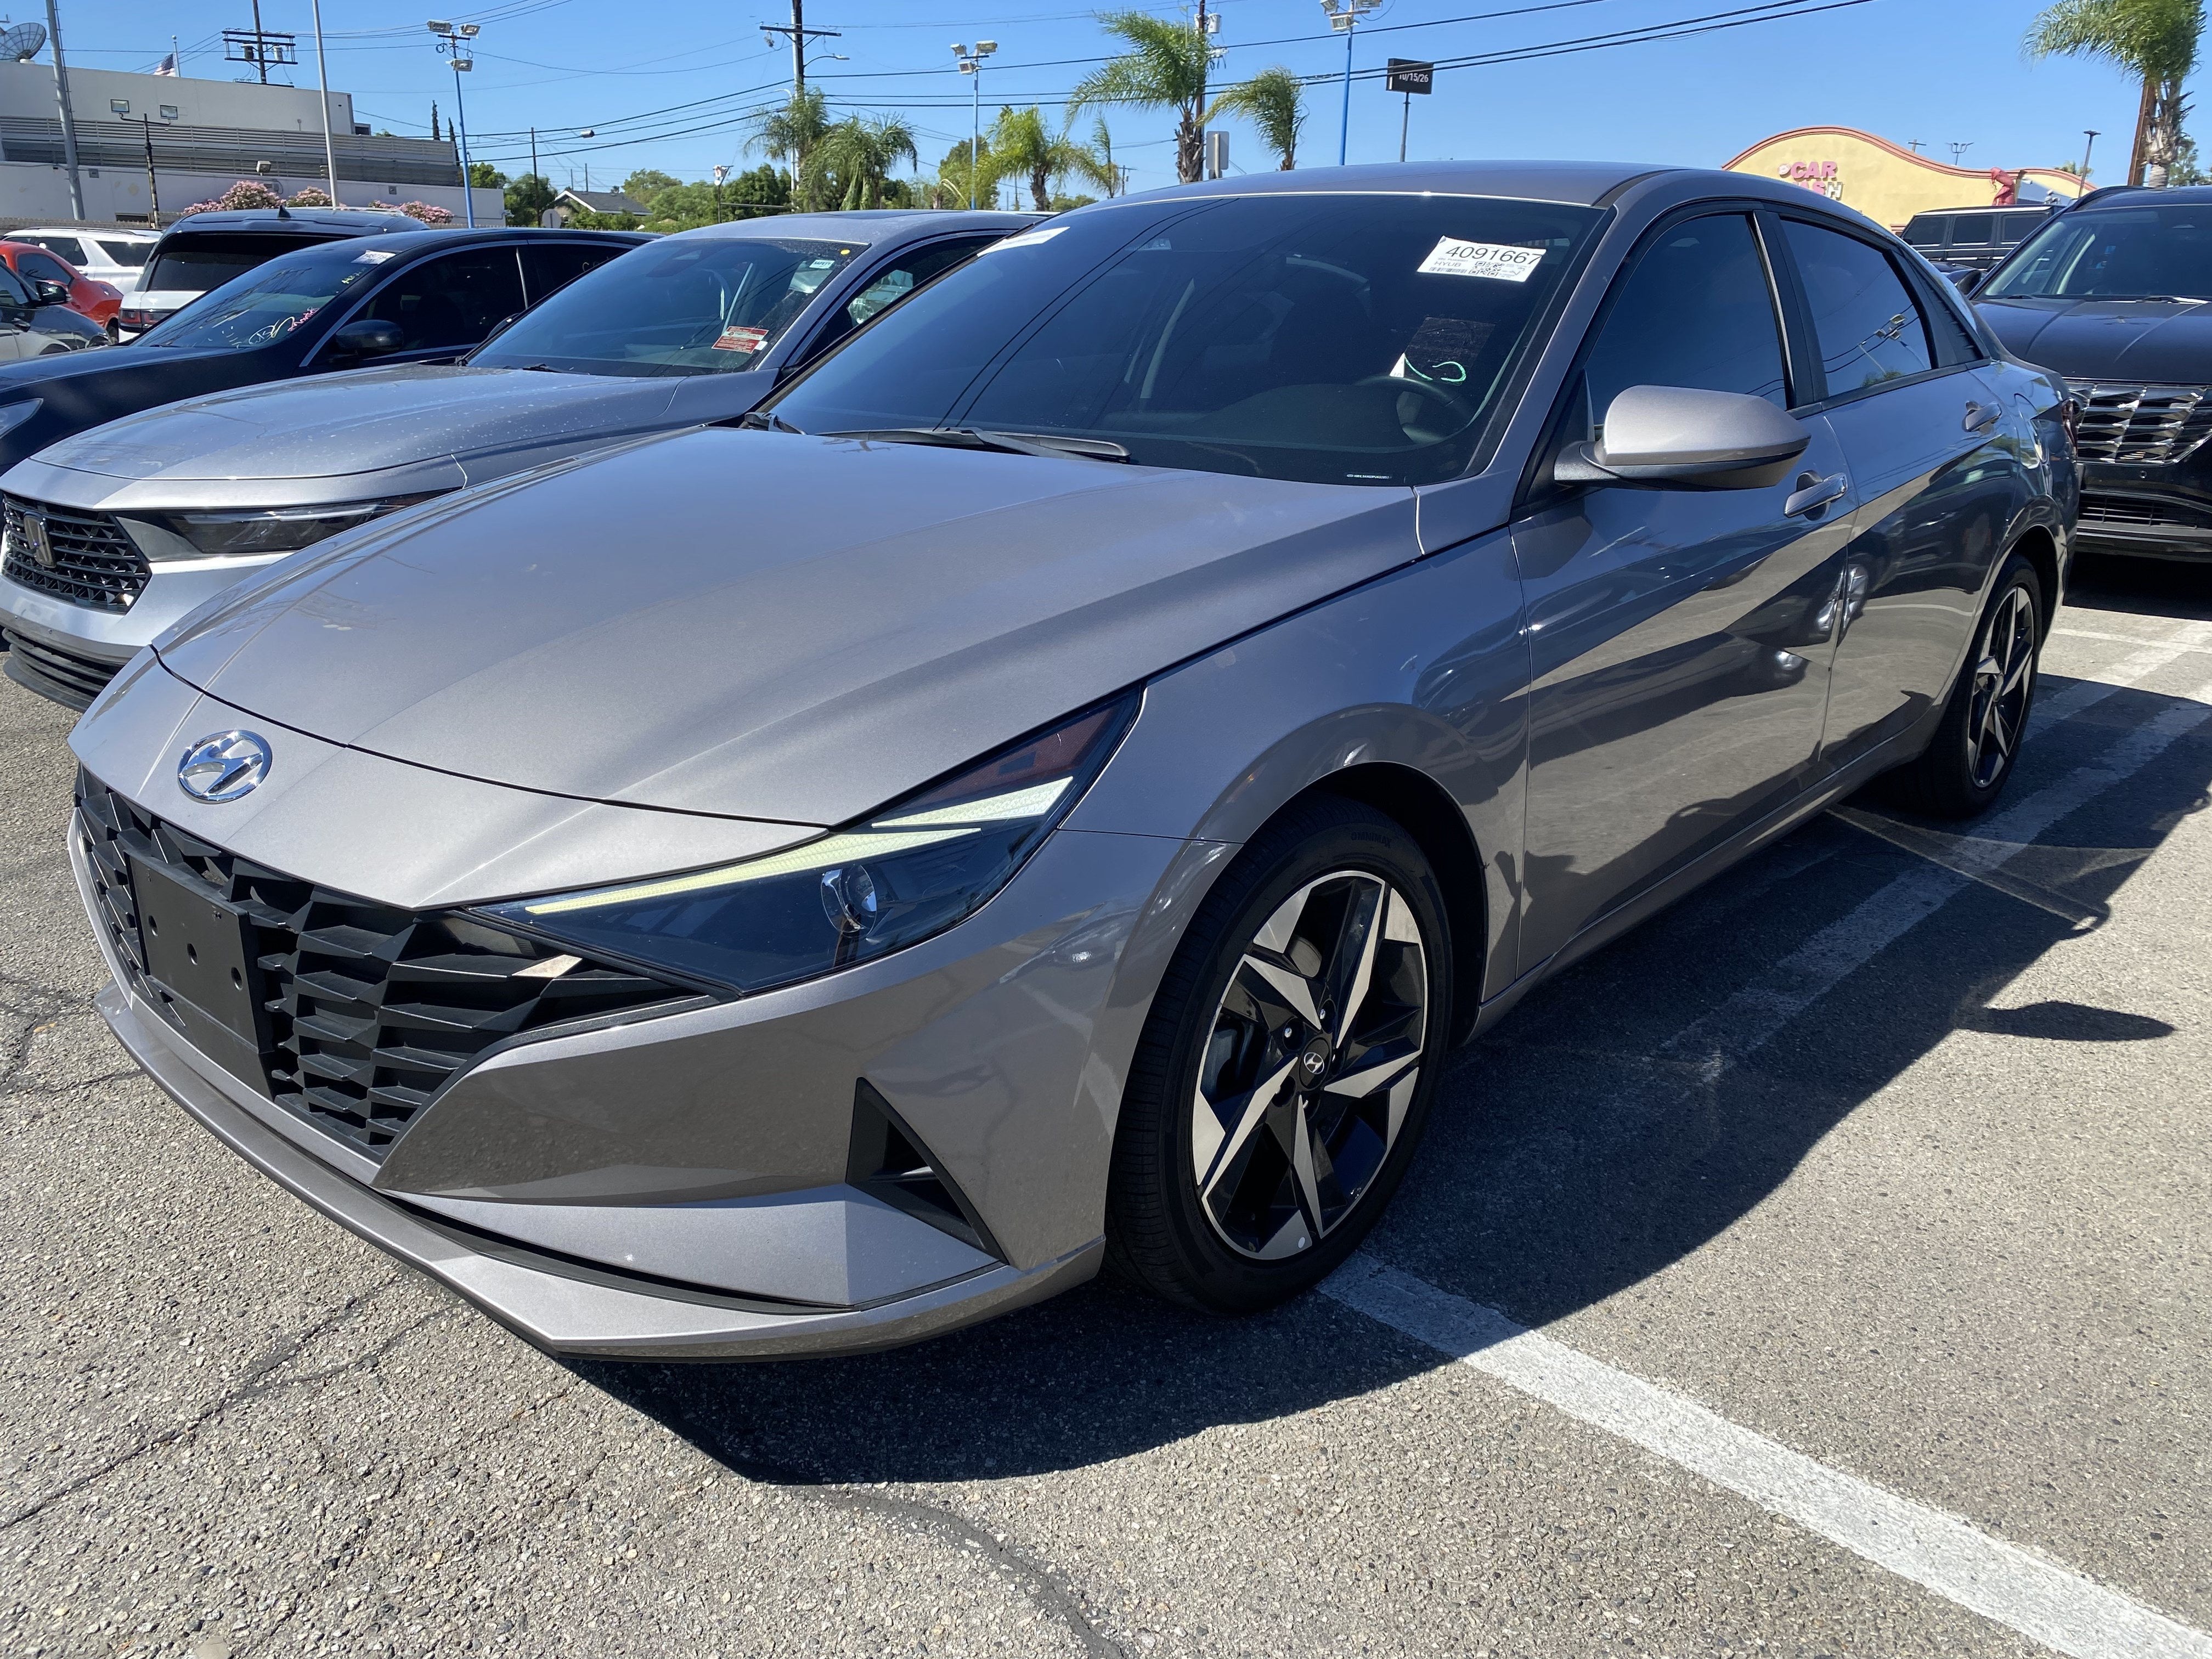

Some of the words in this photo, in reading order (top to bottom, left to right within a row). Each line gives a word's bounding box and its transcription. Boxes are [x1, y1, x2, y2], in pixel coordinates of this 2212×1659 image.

[1790, 161, 1837, 179] CAR
[1792, 180, 1843, 200] SH
[1446, 246, 1543, 264] 4091667
